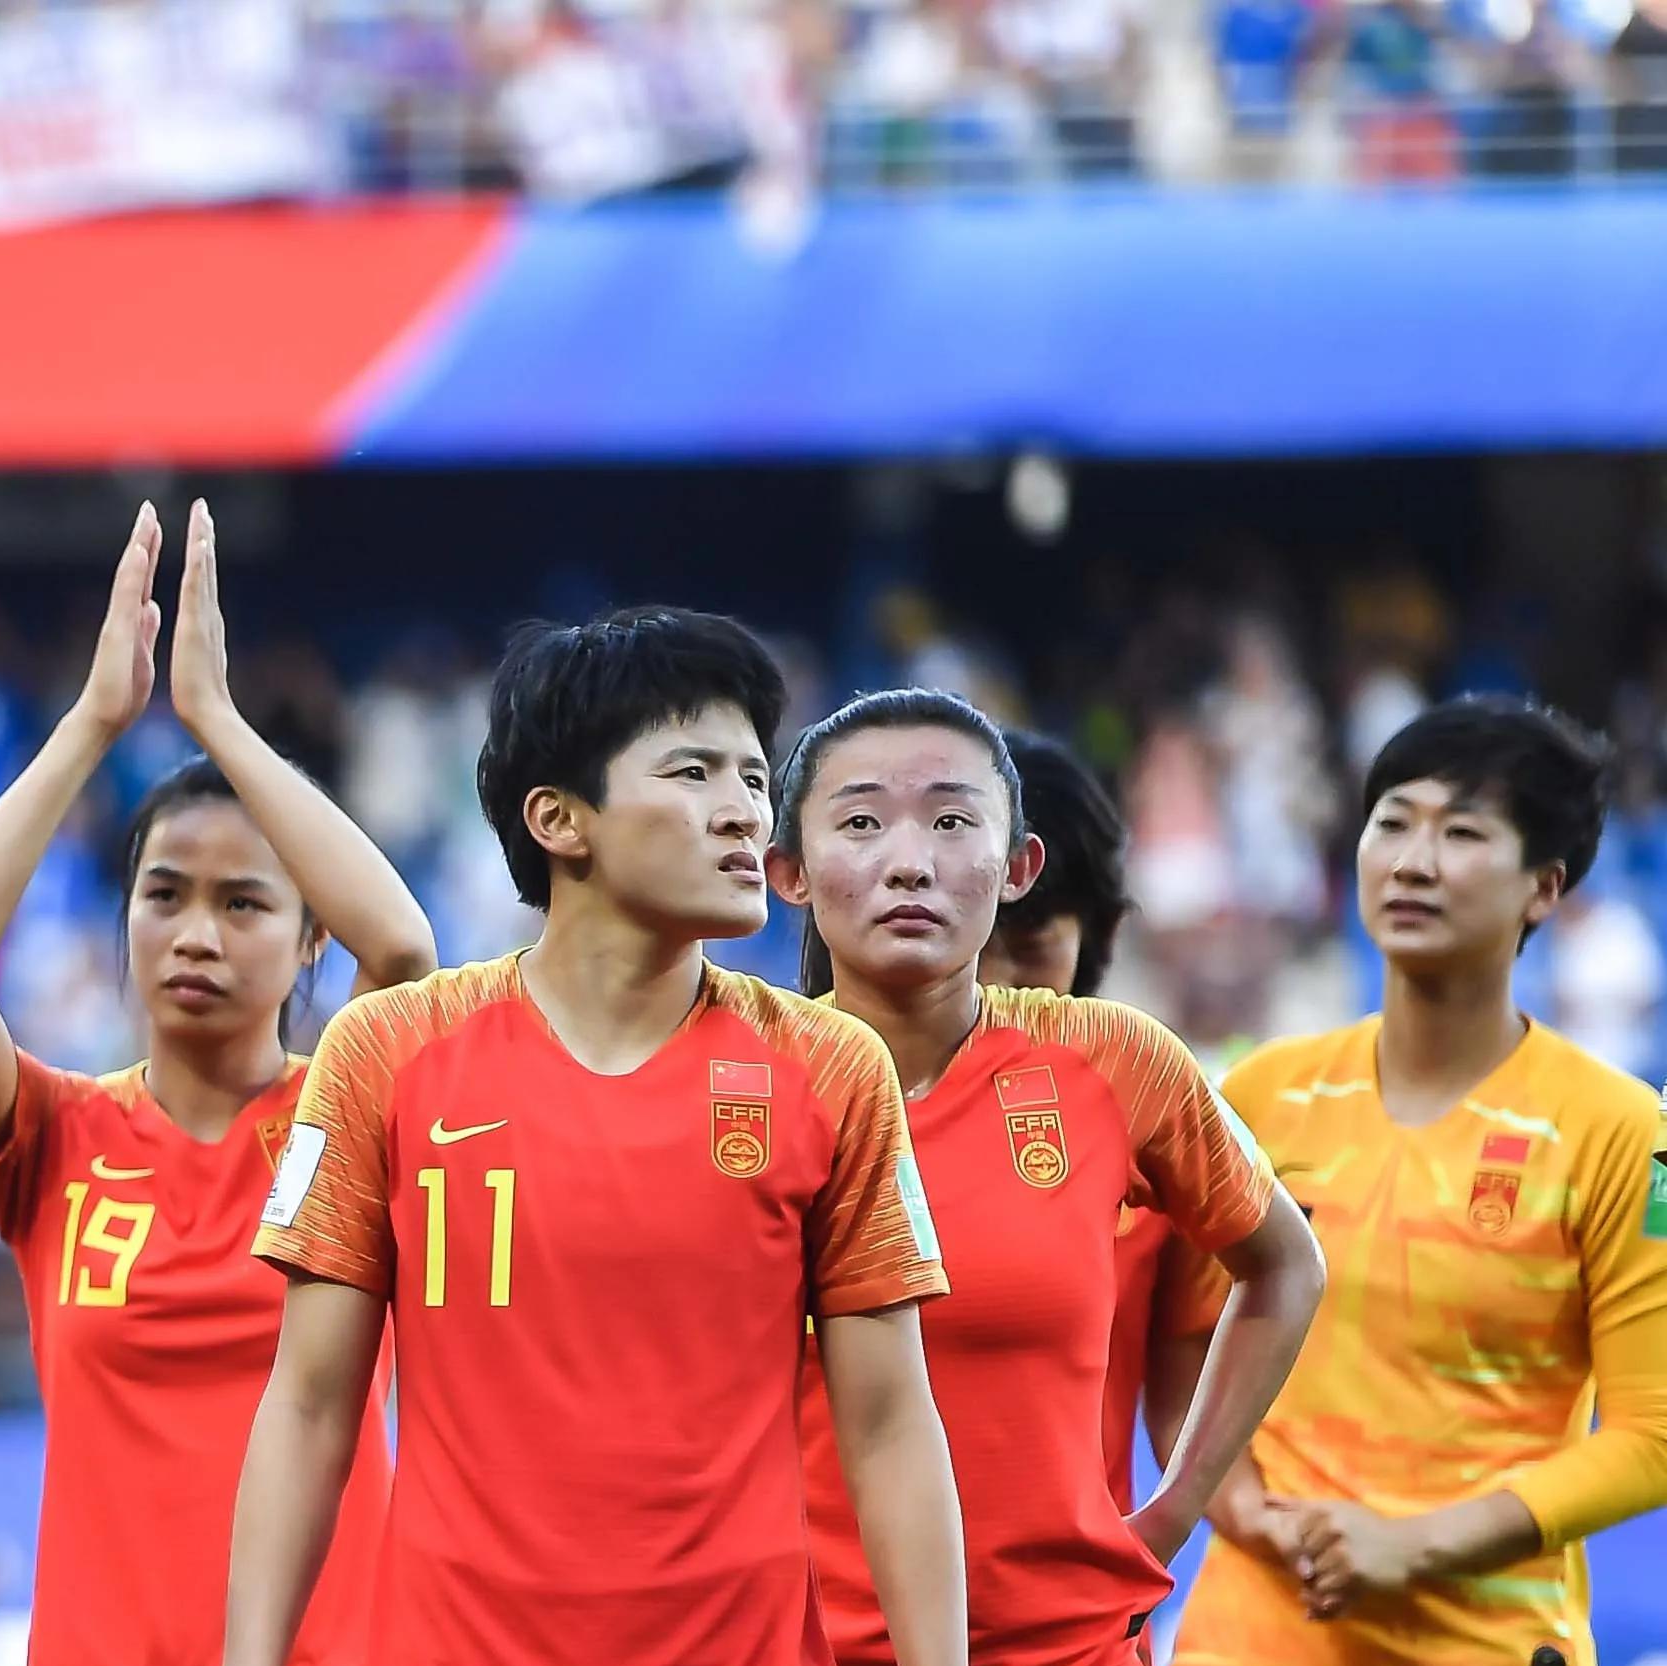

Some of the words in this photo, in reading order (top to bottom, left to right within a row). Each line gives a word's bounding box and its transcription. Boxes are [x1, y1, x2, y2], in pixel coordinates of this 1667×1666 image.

[716, 1105, 764, 1122] CFA
[1009, 1115, 1057, 1132] CFA
[58, 1181, 156, 1308] 19
[416, 1168, 516, 1307] 11
